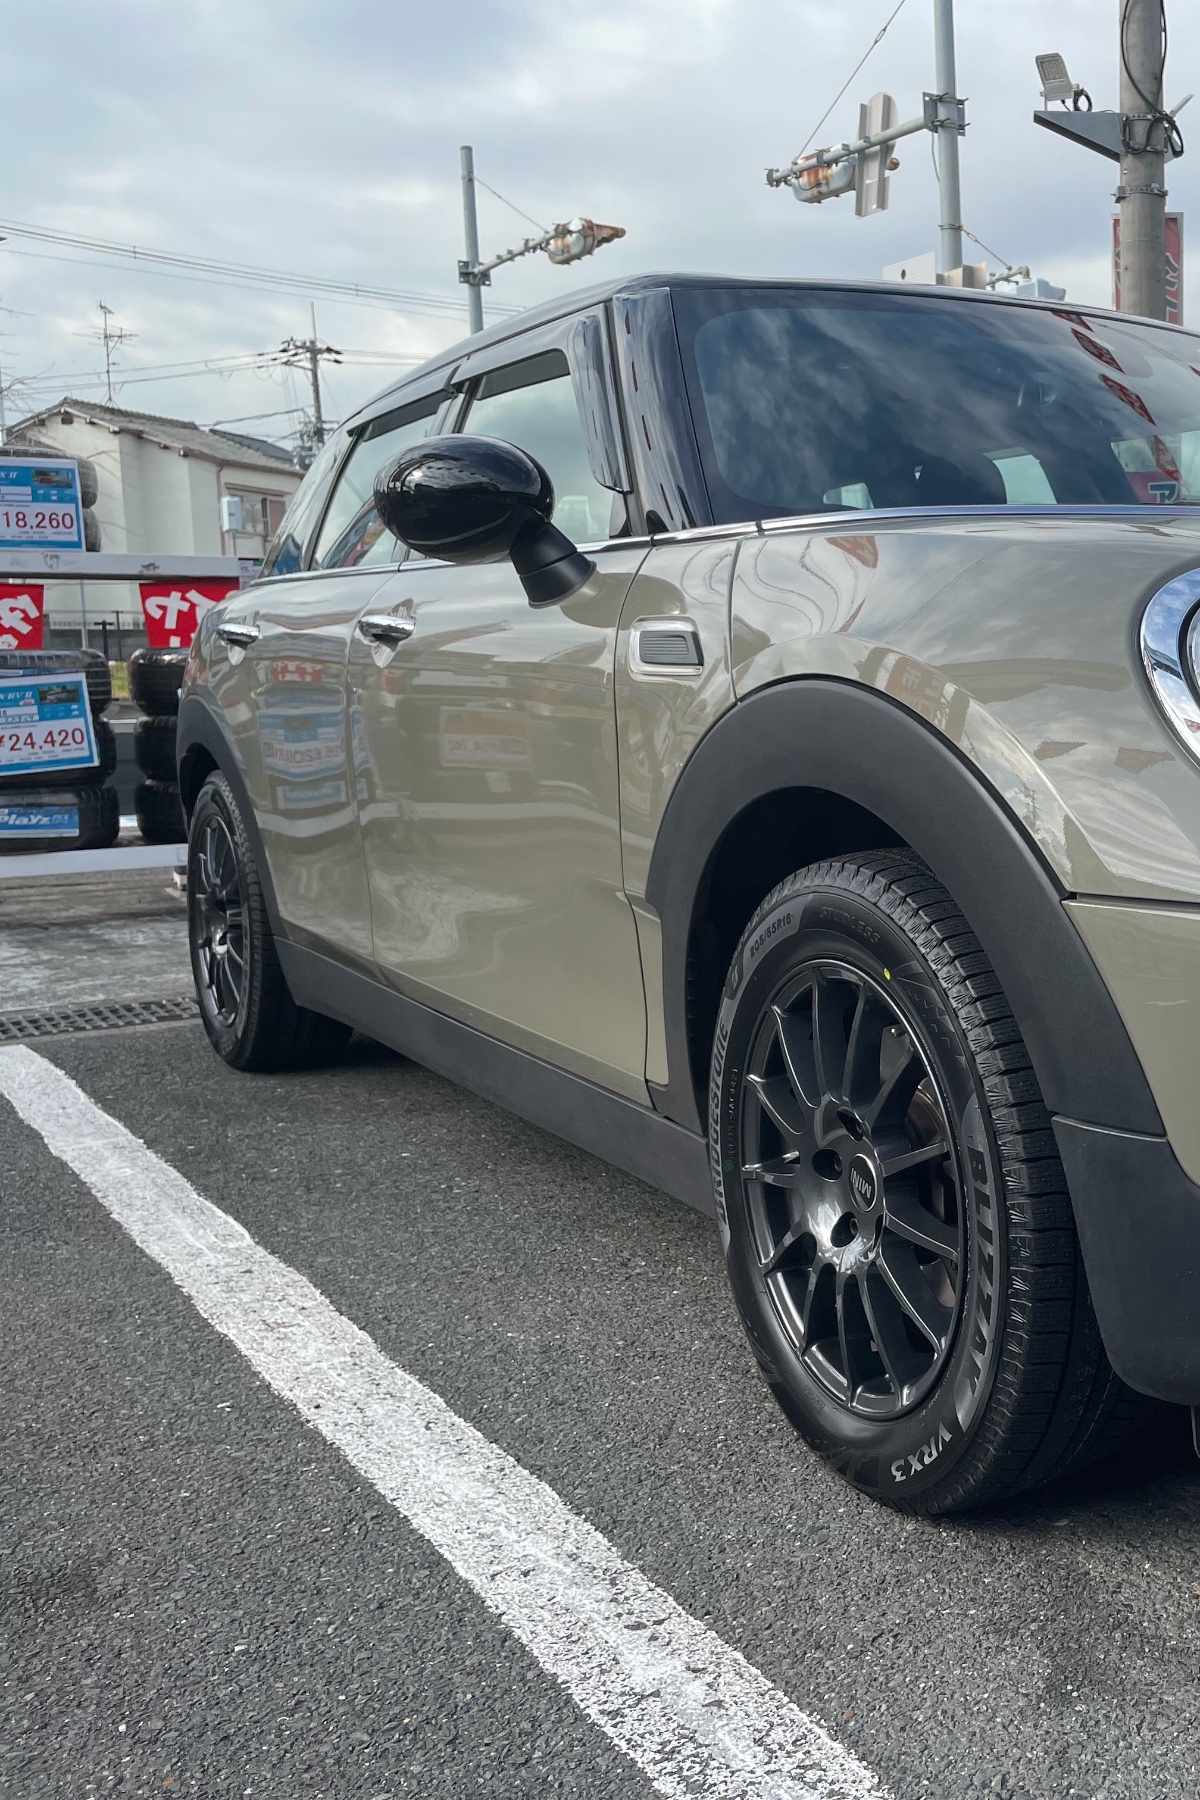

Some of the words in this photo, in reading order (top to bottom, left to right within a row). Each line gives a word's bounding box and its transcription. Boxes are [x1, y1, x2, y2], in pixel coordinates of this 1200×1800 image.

[2, 511, 74, 530] 18,260
[749, 912, 792, 960] 205/55R16
[818, 906, 881, 944] STUDLESS
[709, 1018, 729, 1226] BRIDGESTONE
[850, 1168, 872, 1199] MINI
[959, 1144, 995, 1397] BLIZZAK
[890, 1420, 953, 1483] VRX3
